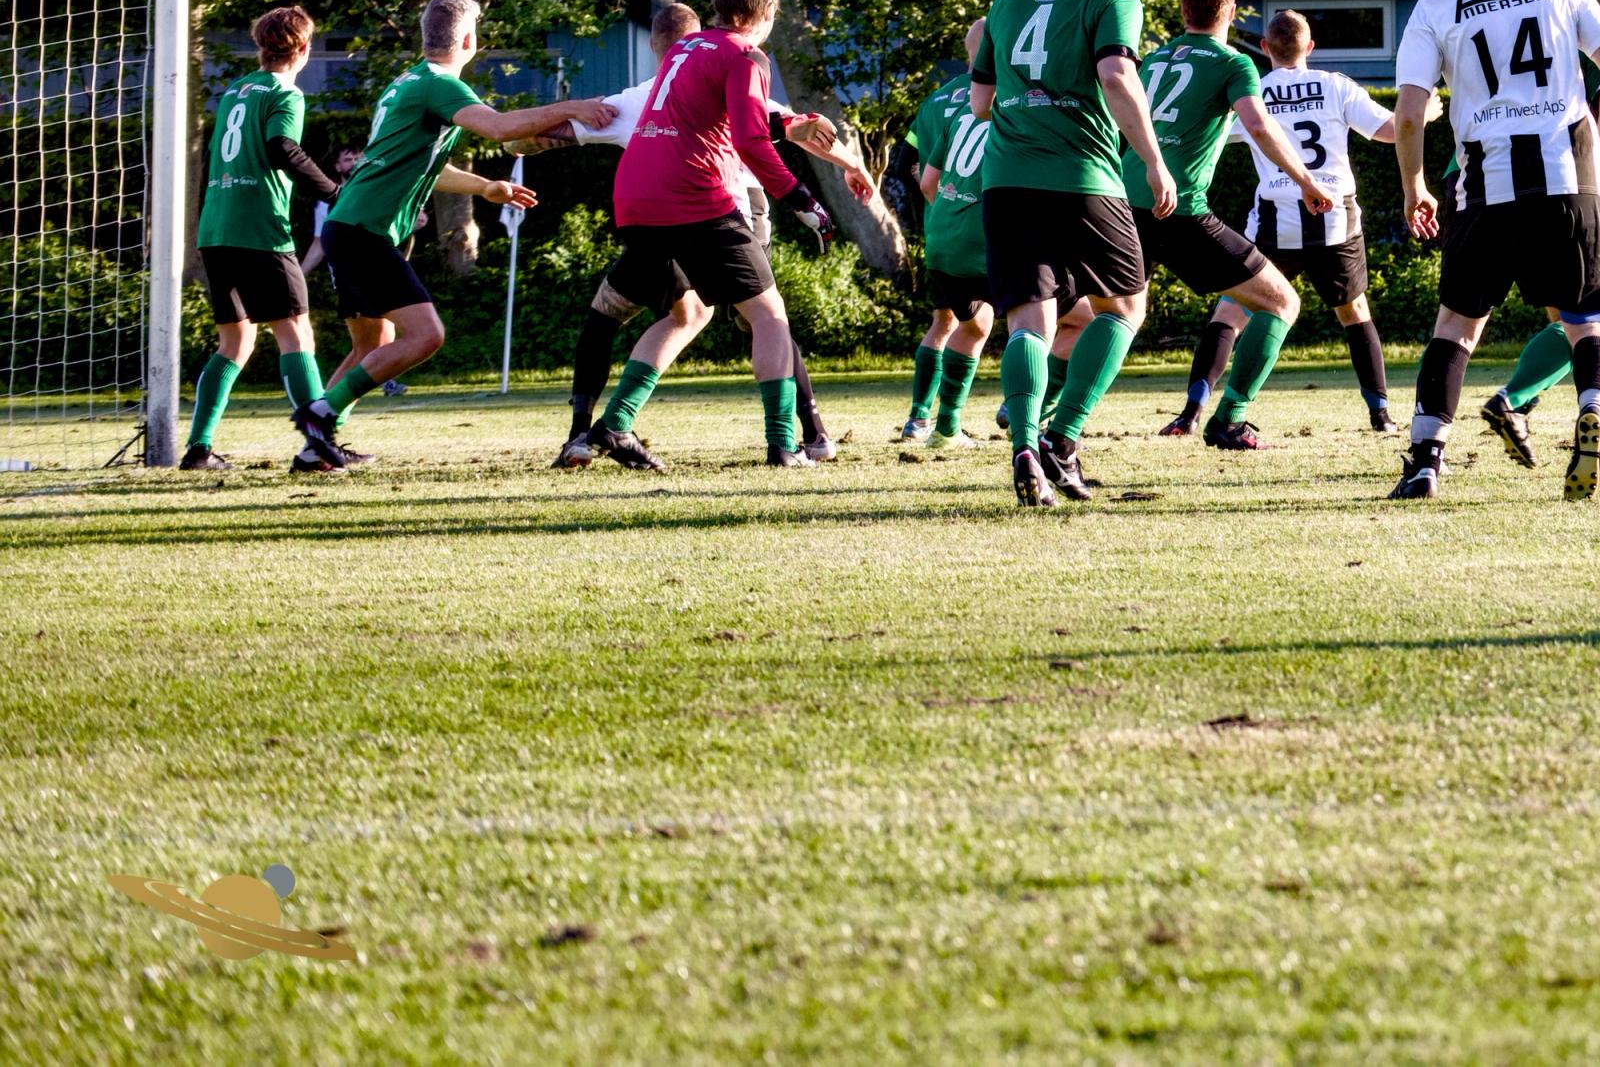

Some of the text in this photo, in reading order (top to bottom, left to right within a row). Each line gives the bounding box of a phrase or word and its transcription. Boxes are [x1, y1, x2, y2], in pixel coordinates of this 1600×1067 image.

[1010, 3, 1053, 80] 4
[1470, 16, 1553, 99] 14
[652, 53, 689, 110] 1
[1145, 61, 1193, 123] 12
[1473, 99, 1566, 124] MIFF Invest ApS
[221, 102, 246, 162] 8
[944, 114, 991, 177] 10
[1278, 120, 1327, 172] 3
[1269, 177, 1290, 189] MIFF
